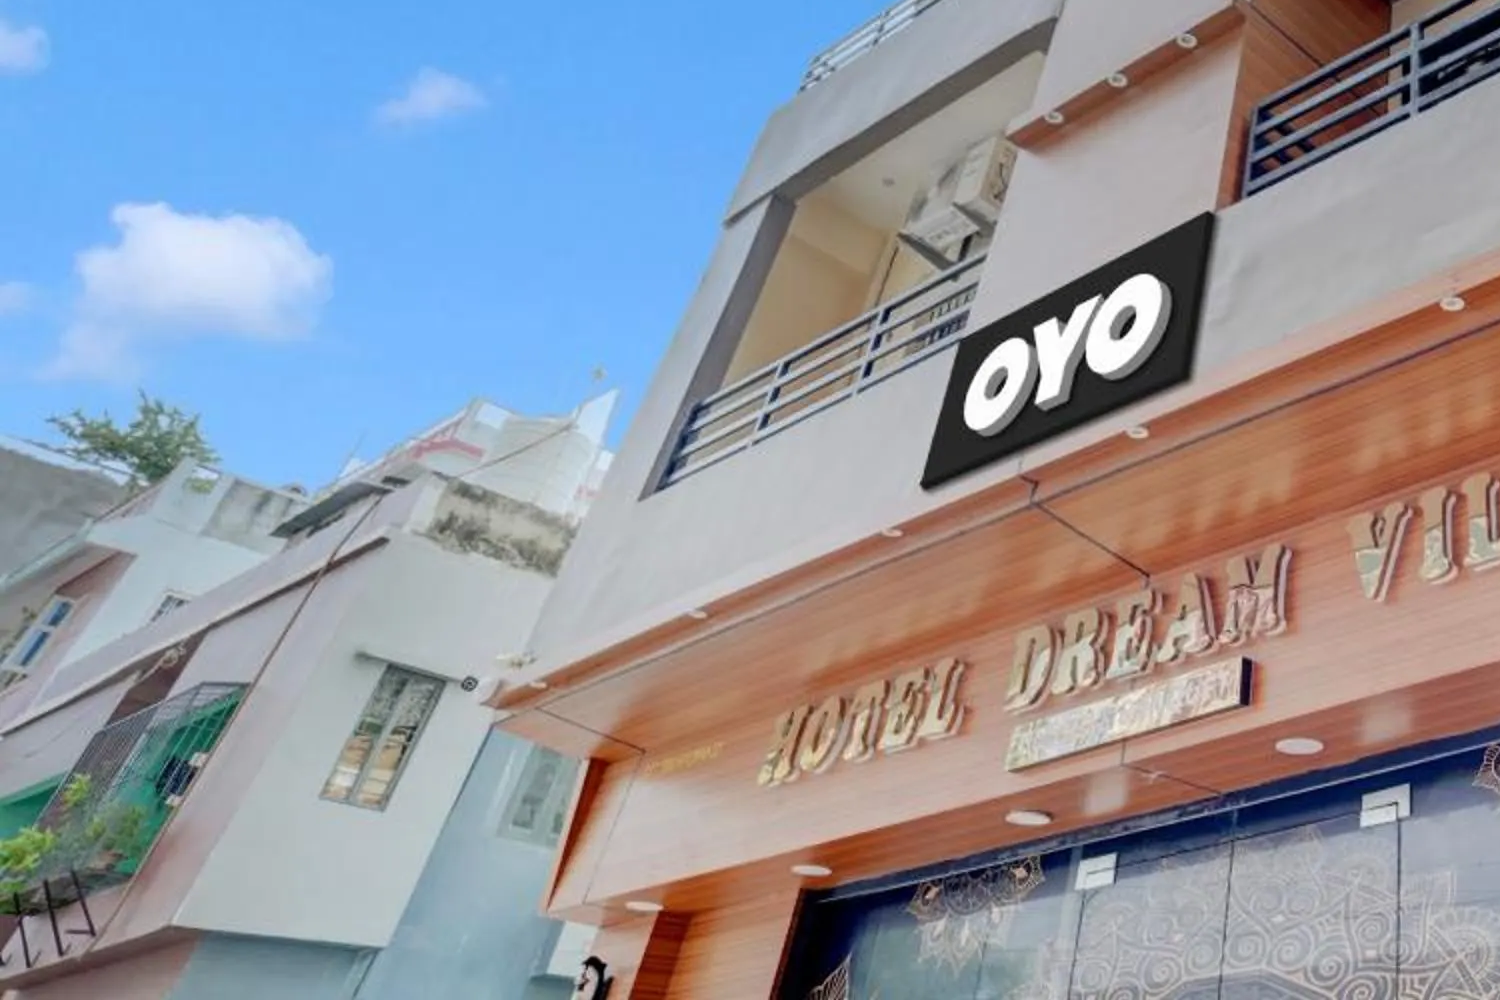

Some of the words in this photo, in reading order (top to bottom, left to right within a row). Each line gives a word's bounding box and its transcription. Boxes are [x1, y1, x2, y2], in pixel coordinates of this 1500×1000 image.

[963, 273, 1172, 437] OYO
[757, 657, 965, 788] HOTEL
[1002, 544, 1292, 713] DREAM
